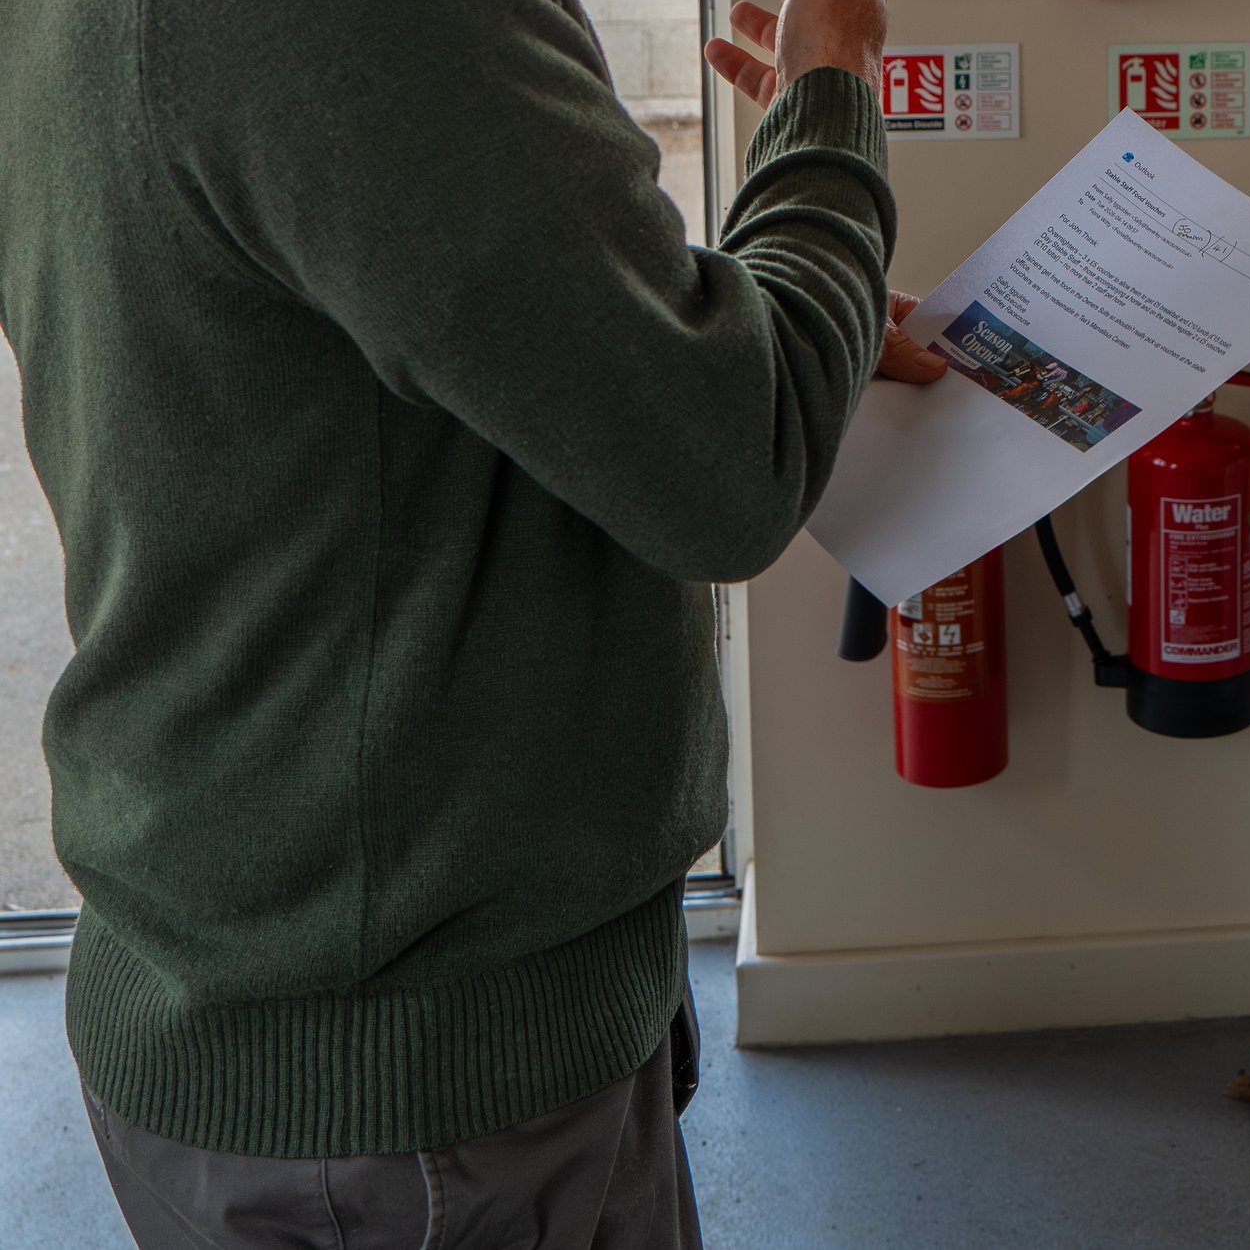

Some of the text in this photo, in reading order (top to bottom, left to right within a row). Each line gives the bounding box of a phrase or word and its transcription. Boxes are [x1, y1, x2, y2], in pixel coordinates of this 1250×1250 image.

[1134, 161, 1155, 180] Outlook
[1084, 191, 1096, 202] Date
[1096, 200, 1105, 209] Tue
[1092, 184, 1104, 195] From
[1103, 193, 1115, 204] Sally
[1105, 169, 1166, 218] Stable Staff Food Vouchers
[1059, 213, 1070, 224] For
[1068, 222, 1082, 235] John
[1089, 207, 1102, 219] Fiona
[1015, 258, 1033, 273] office.
[1022, 250, 1043, 270] Trainers
[1040, 268, 1052, 277] get
[1050, 274, 1062, 284] free
[1059, 281, 1072, 292] food
[1074, 292, 1083, 300] the
[1033, 238, 1049, 251] (£10
[1046, 247, 1062, 262] total)
[1062, 261, 1071, 270] no
[1069, 267, 1083, 279] more
[1081, 276, 1093, 286] than
[1095, 286, 1108, 294] staff
[1040, 232, 1053, 244] Day
[1050, 241, 1068, 257] Stable
[1067, 254, 1081, 266] Staff
[1082, 266, 1098, 278] those
[1094, 275, 1127, 298] accompanying
[1140, 303, 1152, 312] and
[1149, 308, 1157, 316] on
[1047, 226, 1079, 254] Overnighters
[1089, 260, 1099, 268] £5
[1096, 265, 1115, 280] voucher
[1118, 281, 1131, 290] allow
[1129, 287, 1142, 297] them
[1144, 297, 1156, 305] get
[1157, 304, 1181, 320] breakfast
[1176, 317, 1190, 325] and
[990, 282, 1027, 313] Chief Executive
[996, 275, 1030, 305] Sally Iggulden
[1010, 262, 1034, 285] Vouchers
[1031, 281, 1041, 292] are
[1039, 289, 1051, 299] only
[1049, 296, 1075, 315] redeemable
[983, 288, 1031, 326] Beverley Racecourse
[961, 333, 1001, 365] Opener
[973, 320, 1013, 353] Season
[1171, 503, 1231, 524] Water
[1164, 642, 1238, 657] COMMANDER
